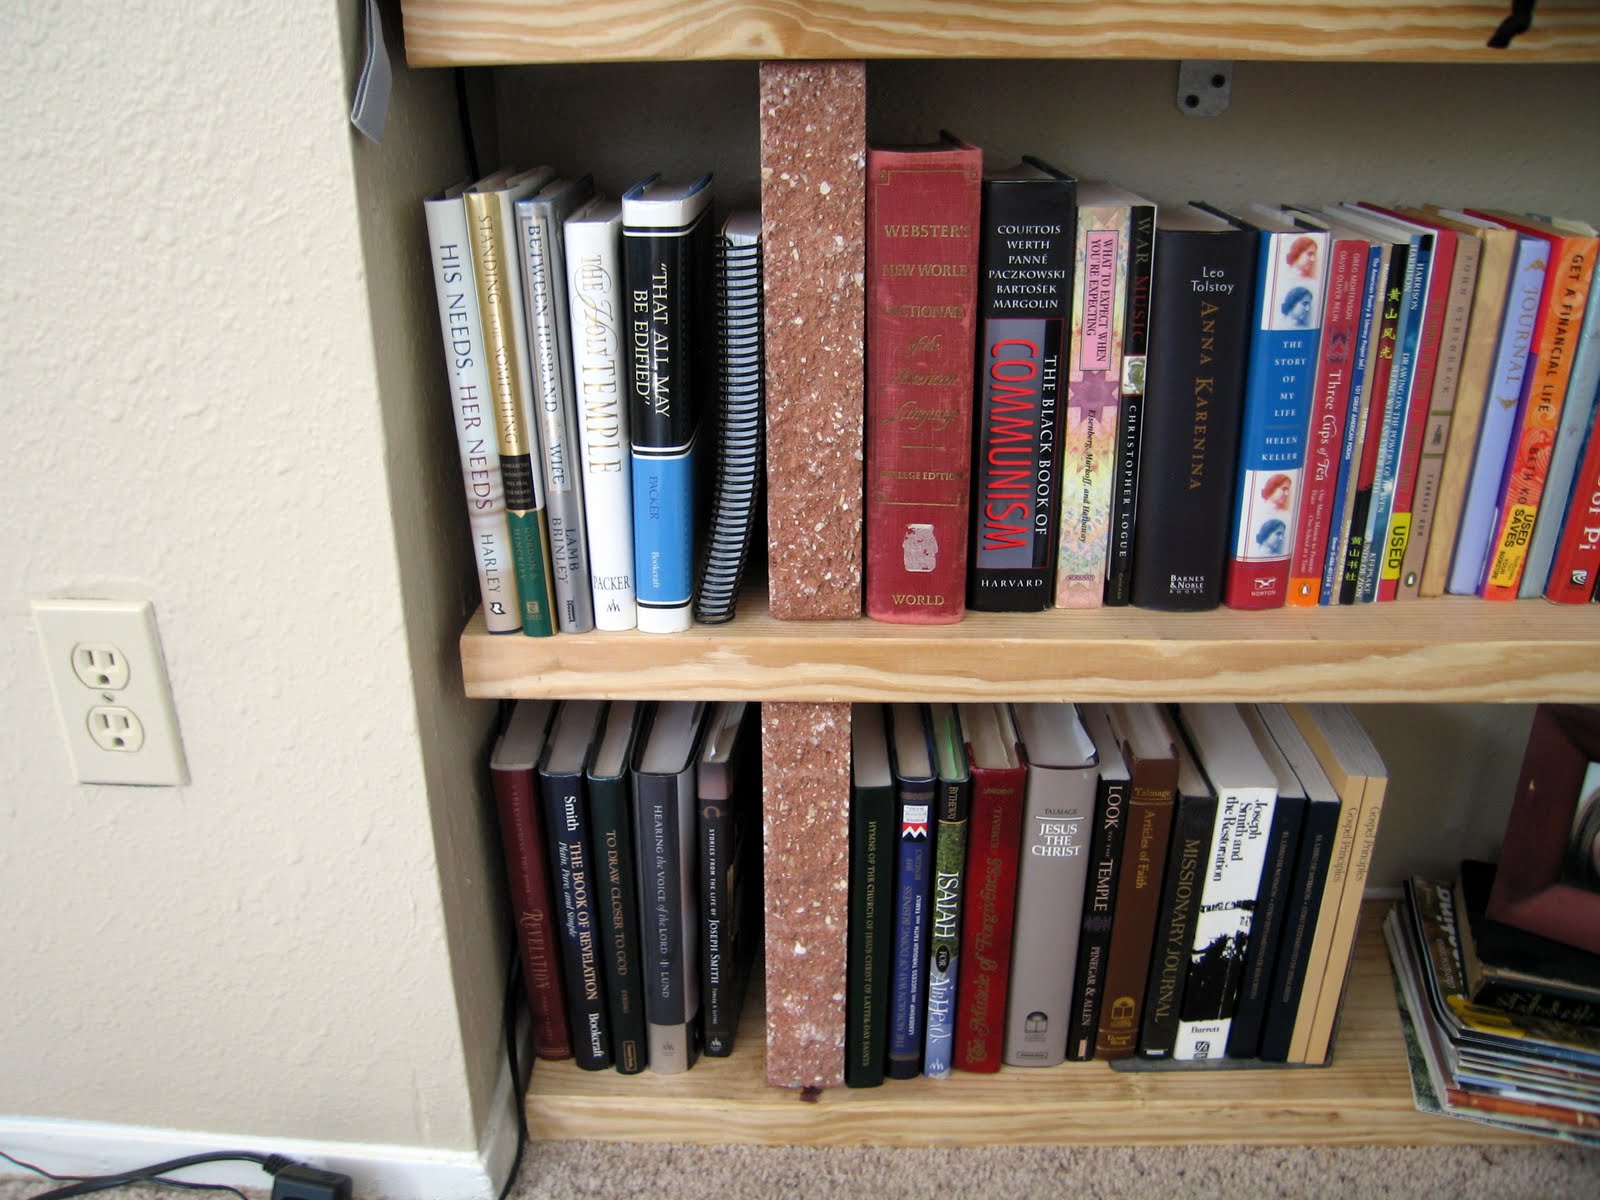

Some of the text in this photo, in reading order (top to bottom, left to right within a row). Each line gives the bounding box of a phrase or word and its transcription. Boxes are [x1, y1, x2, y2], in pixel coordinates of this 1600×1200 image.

[884, 224, 970, 238] WEBSTER'S
[997, 225, 1061, 235] COURTOIS
[1006, 240, 1050, 250] WERTH
[440, 244, 462, 283] HIS
[478, 215, 502, 305] STANDING
[528, 224, 550, 317] BETWEEN
[581, 254, 604, 294] THE
[988, 270, 1065, 280] PACZKOWSKI
[1008, 254, 1048, 264] PANNÉ
[1202, 266, 1224, 278] Leo
[1338, 251, 1346, 272] DAVID
[1402, 244, 1417, 292] HARRISON
[633, 290, 648, 313] BE
[996, 283, 1056, 294] BARTOŠEK
[1086, 239, 1101, 336] YOU'RE EXPECTING
[1096, 238, 1113, 362] WHAT TO EXPECT WHEN
[1132, 218, 1152, 343] WAR MUSIC
[1191, 280, 1234, 294] Tolstoy
[1335, 274, 1344, 300] OLIVER
[1409, 262, 1424, 310] HARRISON
[992, 300, 1058, 308] MARGOLIN
[654, 332, 669, 370] ALL
[1506, 288, 1538, 384] JOURNAL
[1538, 254, 1584, 412] GET FINANCIAL LIFE
[538, 325, 558, 412] HUSBAND
[1274, 358, 1306, 366] STORY
[1398, 352, 1410, 395] DRAWING
[459, 385, 482, 430] HER
[655, 376, 670, 418] MAY
[1190, 300, 1220, 490] ANNA KARENINA
[1280, 392, 1294, 400] MY
[582, 359, 622, 474] TEMPLE
[1316, 369, 1342, 482] Three Cups Tea
[1344, 396, 1359, 460] GREAT POEMS
[984, 338, 1039, 550] COMMUNISM
[1035, 355, 1058, 535] THE BLACK BOOK OF
[1122, 406, 1137, 504] CHRISTOPHER
[1262, 453, 1298, 461] KELLER
[1266, 436, 1298, 444] HELEN
[467, 438, 492, 510] NEEDS
[550, 443, 565, 485] WIFE
[1523, 448, 1540, 480] BETH
[648, 476, 660, 520] PACKER
[1080, 490, 1090, 544] and Hathaway
[565, 528, 579, 571] LAMB
[1119, 514, 1130, 557] LOGUE
[1388, 526, 1406, 569] USED
[1504, 509, 1525, 548] SAVES
[1516, 514, 1534, 546] USED
[480, 534, 500, 594] HARLEY
[552, 518, 568, 584] BRINLEY
[651, 551, 660, 588] Bookcraft
[593, 575, 631, 590] PACKER
[981, 579, 1043, 588] HARVARD
[1170, 574, 1204, 582] BARNES
[892, 594, 944, 606] WORLD
[564, 796, 580, 831] Smith
[948, 786, 958, 820] BYTHEWAY
[1134, 788, 1171, 797] Talmage
[605, 830, 616, 847] TO
[1038, 824, 1078, 836] JESUS
[1044, 835, 1072, 845] THE
[1212, 796, 1239, 882] the Restoration
[1231, 802, 1252, 861] Smith and
[1248, 799, 1268, 840] Joseph
[1032, 845, 1082, 856] CHRIST
[1094, 786, 1123, 912] LOOK TEMPLE
[1136, 810, 1156, 889] Articles Faith
[1331, 806, 1356, 883] Gospel Principles
[1354, 805, 1379, 882] Gospel Principles
[607, 849, 619, 884] DRAW
[653, 804, 668, 953] HEARING the VOICE LORD
[564, 891, 576, 937] and Simple
[568, 841, 597, 1000] THE BOOK OF REVELATION
[610, 886, 623, 929] CLOSER
[935, 872, 960, 938] ISAIAH
[520, 908, 549, 989] REVELATION
[614, 932, 624, 948] TO
[707, 918, 719, 951] JOSEPH
[862, 820, 877, 1038] HYMNS OF THE CHURCH JESUS CHRIST LATTER-DAY
[1154, 839, 1200, 1024] MISSIONARY JOURNAL
[615, 950, 627, 976] GOD
[710, 954, 720, 983] SMITH
[907, 894, 922, 1035] LEADERSHIP SUCCESS THROUGH FAITH FAMILY
[938, 950, 948, 967] FOR
[660, 971, 670, 997] LUND
[1082, 946, 1100, 1026] PINEGAR ALLEN
[588, 1012, 604, 1057] Bookcraft
[1191, 1026, 1220, 1034] Barrett
